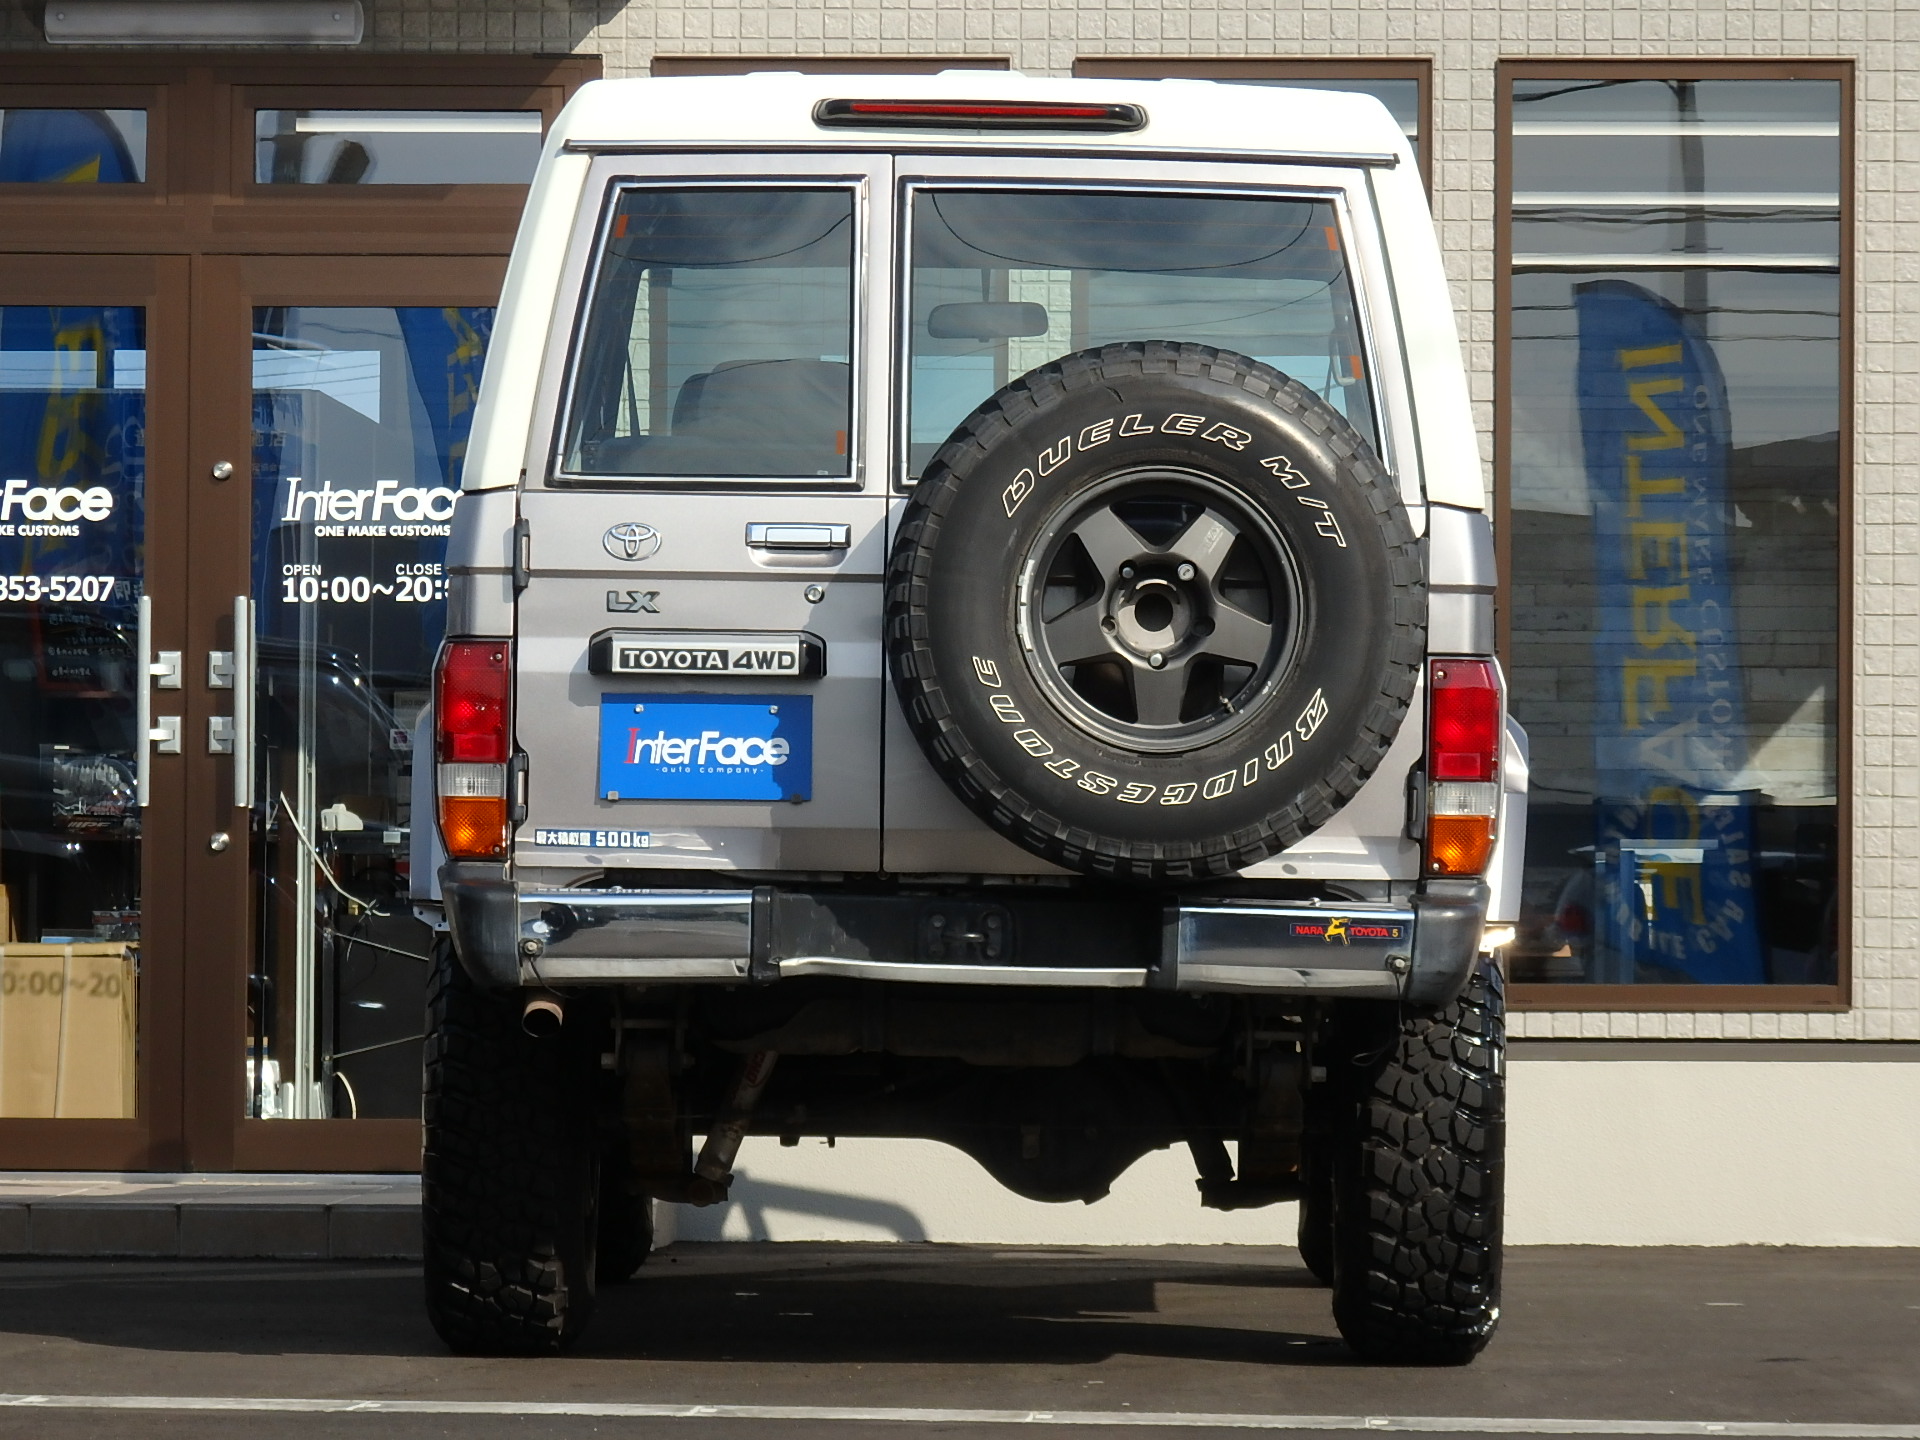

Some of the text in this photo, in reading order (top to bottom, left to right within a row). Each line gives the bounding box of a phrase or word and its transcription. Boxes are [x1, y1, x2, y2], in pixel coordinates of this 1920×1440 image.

[1001, 413, 1251, 517] DUELER
[0, 479, 113, 522] Face
[281, 477, 464, 521] InterFac
[18, 525, 80, 537] CUSTOMS
[314, 525, 451, 537] ONE MAKE CUSTOMS
[282, 564, 322, 576] OPEN
[395, 563, 442, 576] CLOSE
[282, 576, 449, 603] 10:00~20:
[606, 590, 661, 613] LX
[624, 650, 797, 670] TOYOTA 4WD
[972, 655, 1328, 805] BRIDGESTONE
[623, 727, 790, 766] InterFace
[1295, 925, 1324, 935] NARA
[1350, 927, 1389, 937] TOYOTA
